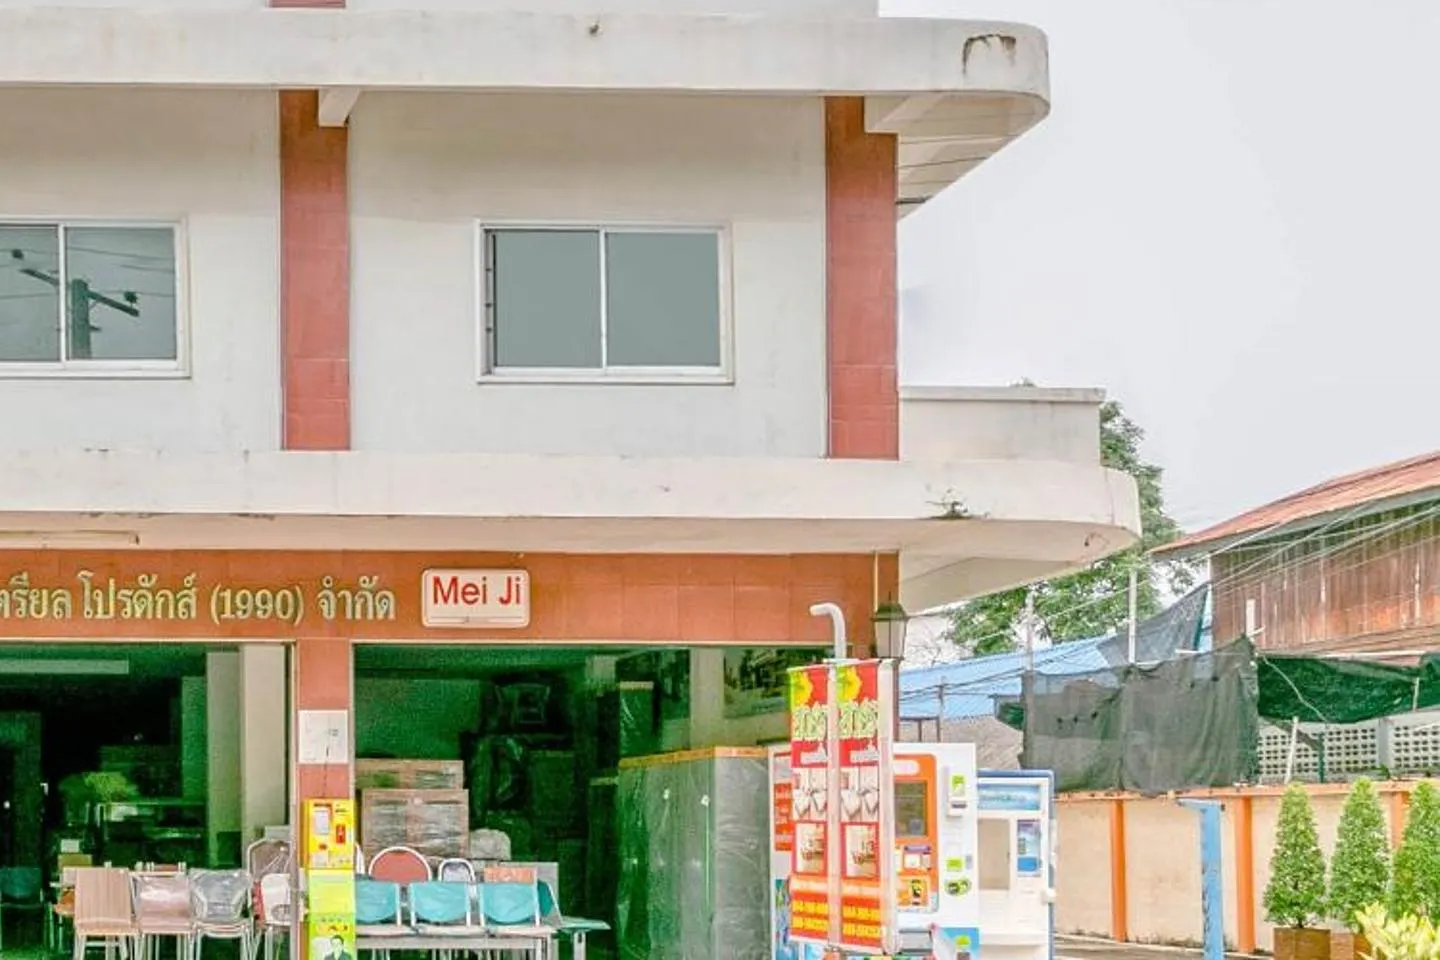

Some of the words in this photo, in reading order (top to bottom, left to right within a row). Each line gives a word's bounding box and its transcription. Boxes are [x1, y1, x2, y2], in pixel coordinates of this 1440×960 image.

[77, 570, 197, 620] โปรดักส์
[210, 586, 305, 625] (1990)
[317, 575, 396, 621] จำกัด
[431, 575, 489, 606] Mei
[498, 575, 522, 606] Ji
